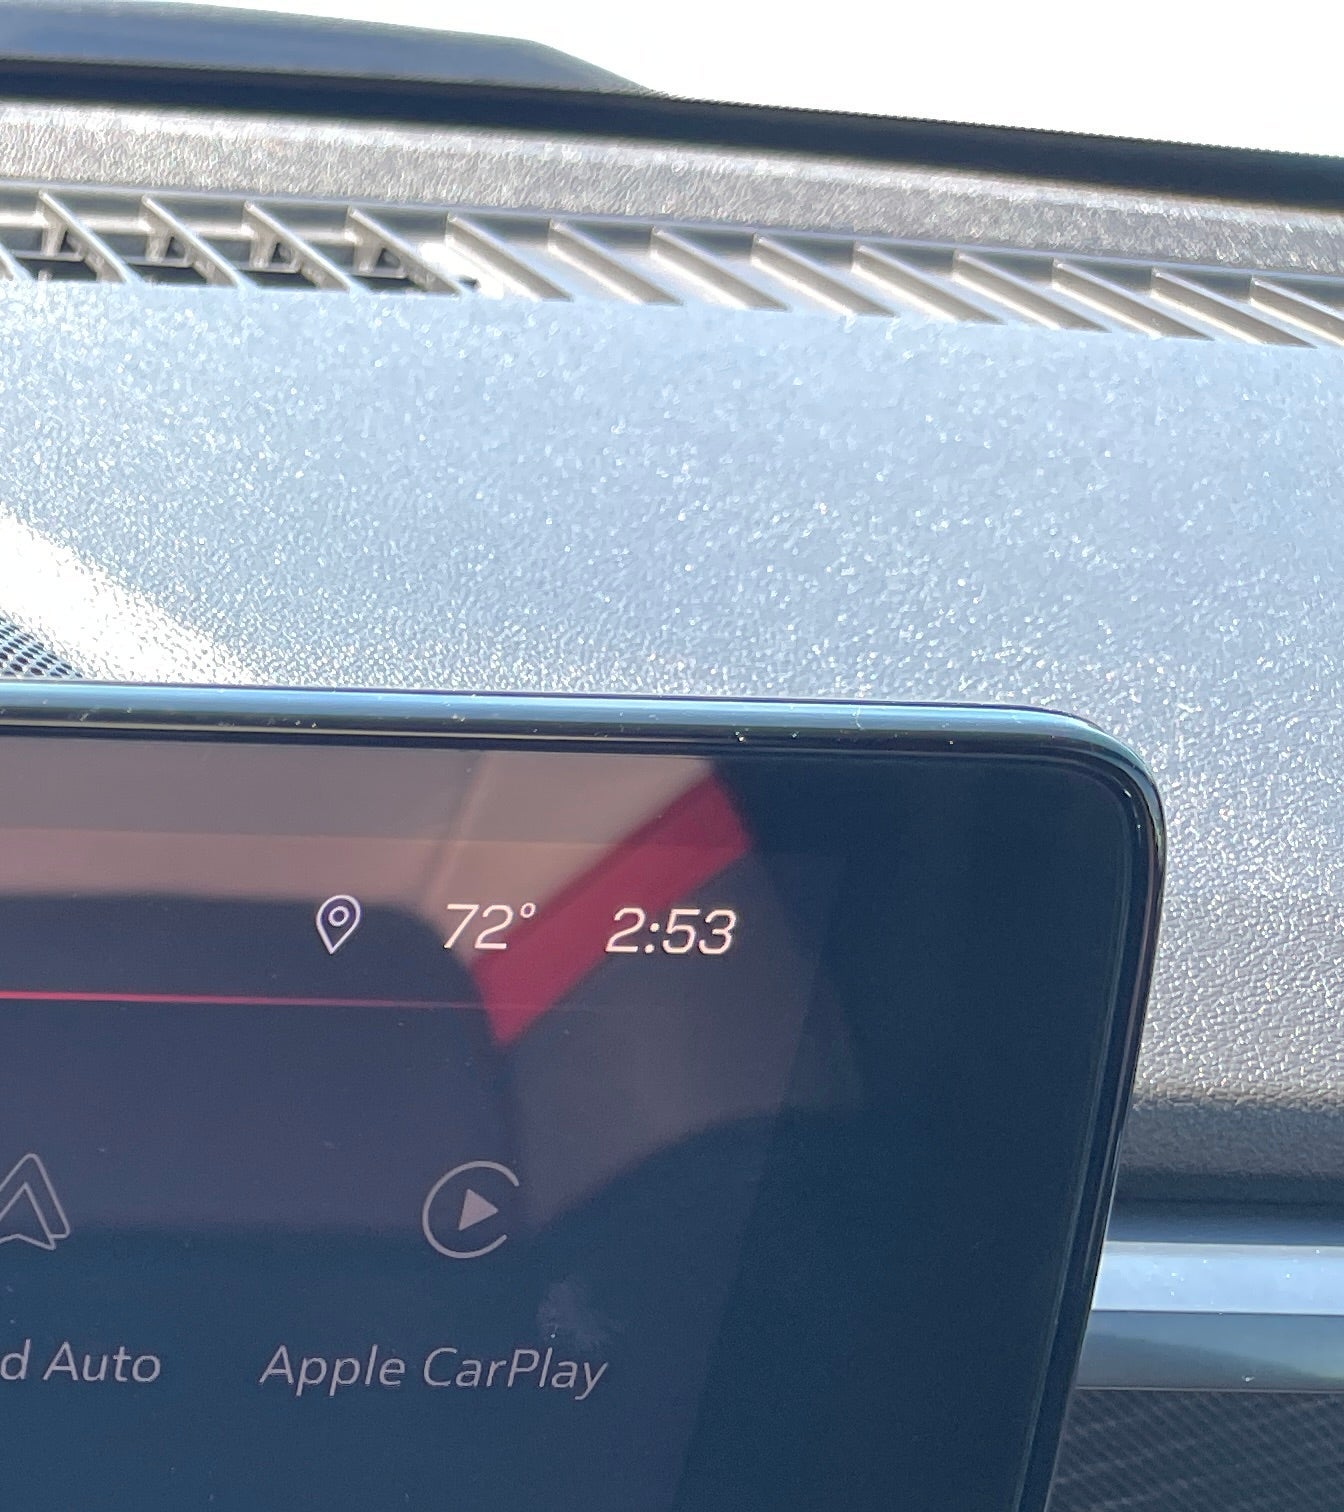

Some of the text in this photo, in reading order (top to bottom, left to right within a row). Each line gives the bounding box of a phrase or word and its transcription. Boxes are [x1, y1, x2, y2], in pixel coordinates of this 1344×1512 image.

[443, 902, 536, 950] 72°
[605, 907, 737, 955] 2:53
[42, 1341, 161, 1383] Auto
[258, 1343, 609, 1401] Apple CarPlay
